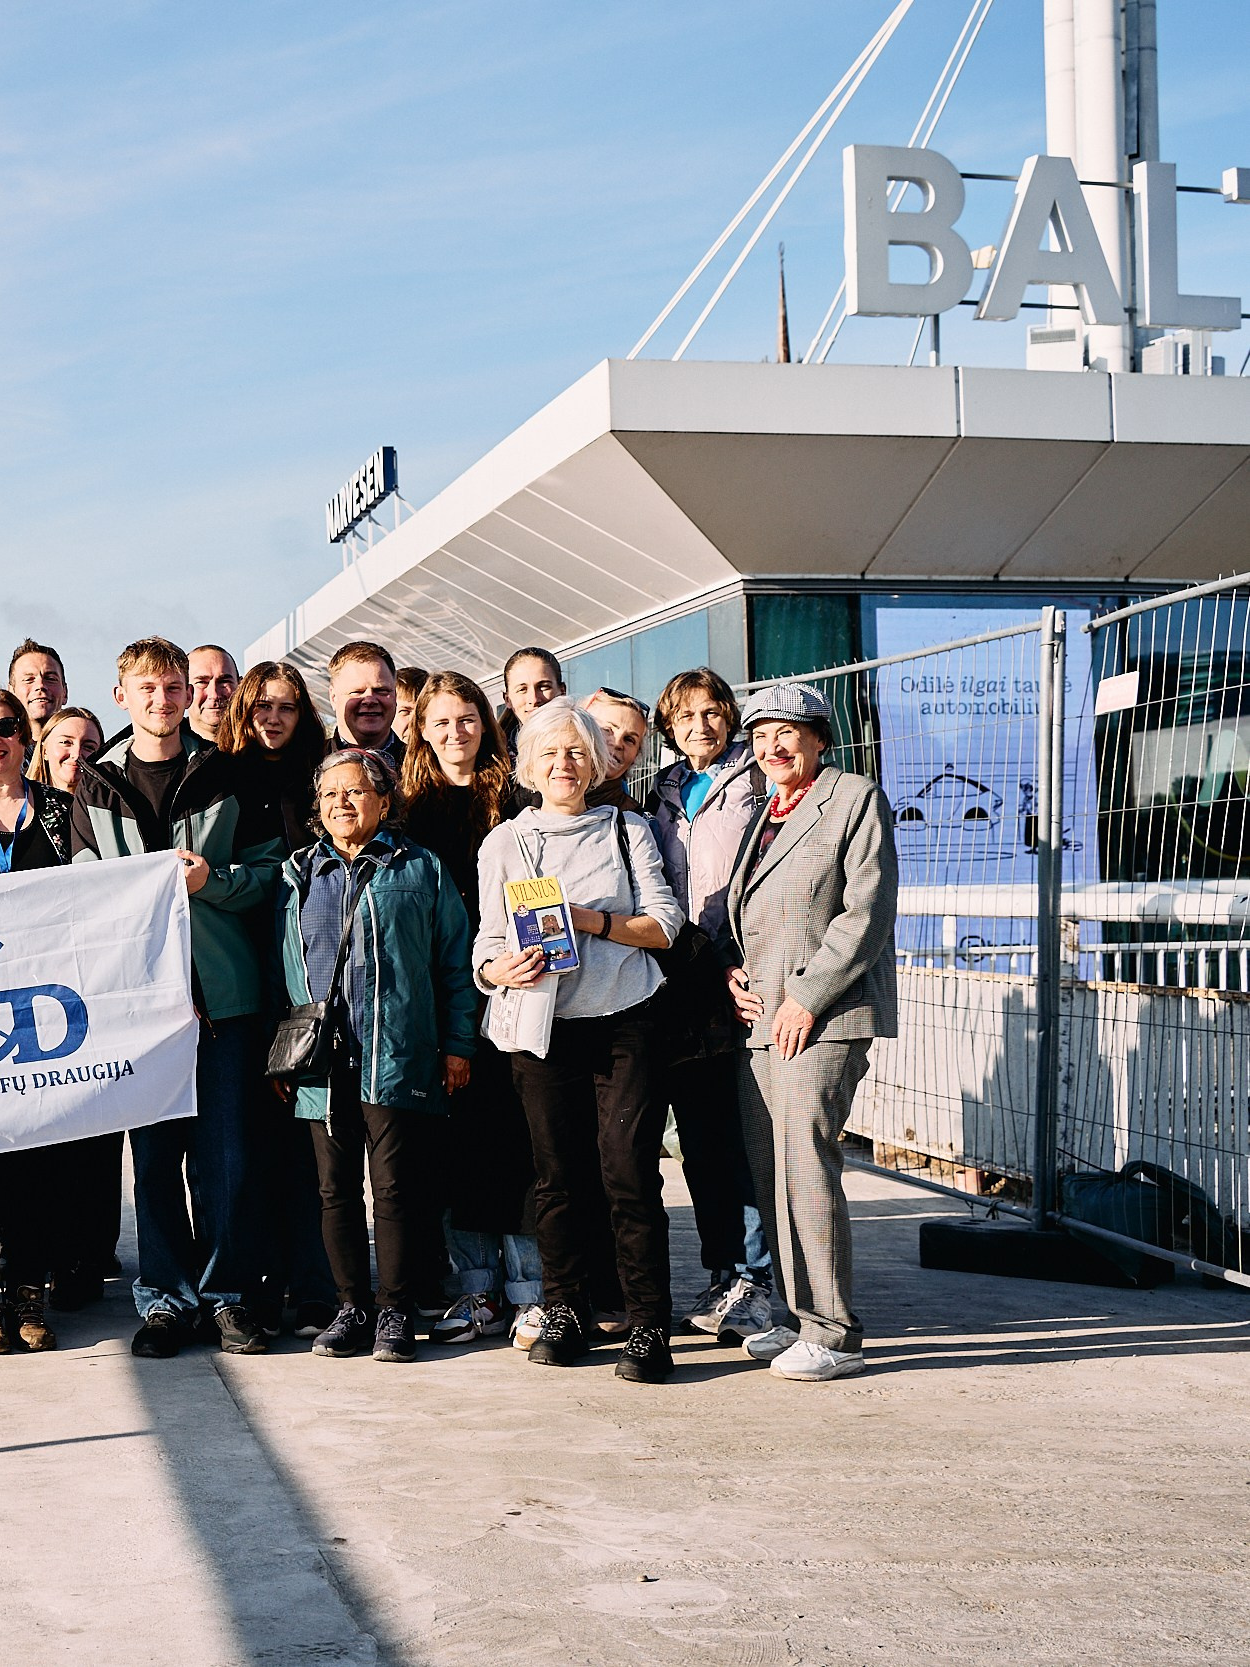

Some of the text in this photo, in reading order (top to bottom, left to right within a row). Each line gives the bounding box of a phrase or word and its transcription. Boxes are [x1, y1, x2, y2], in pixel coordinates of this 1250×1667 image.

[842, 144, 1250, 331] BAL
[325, 446, 385, 544] NARVESEN
[901, 676, 1072, 697] Odilė ilgai taė
[921, 698, 1040, 716] automobili
[510, 878, 557, 902] VILNIUS
[33, 1059, 135, 1090] DRAUGIJA
